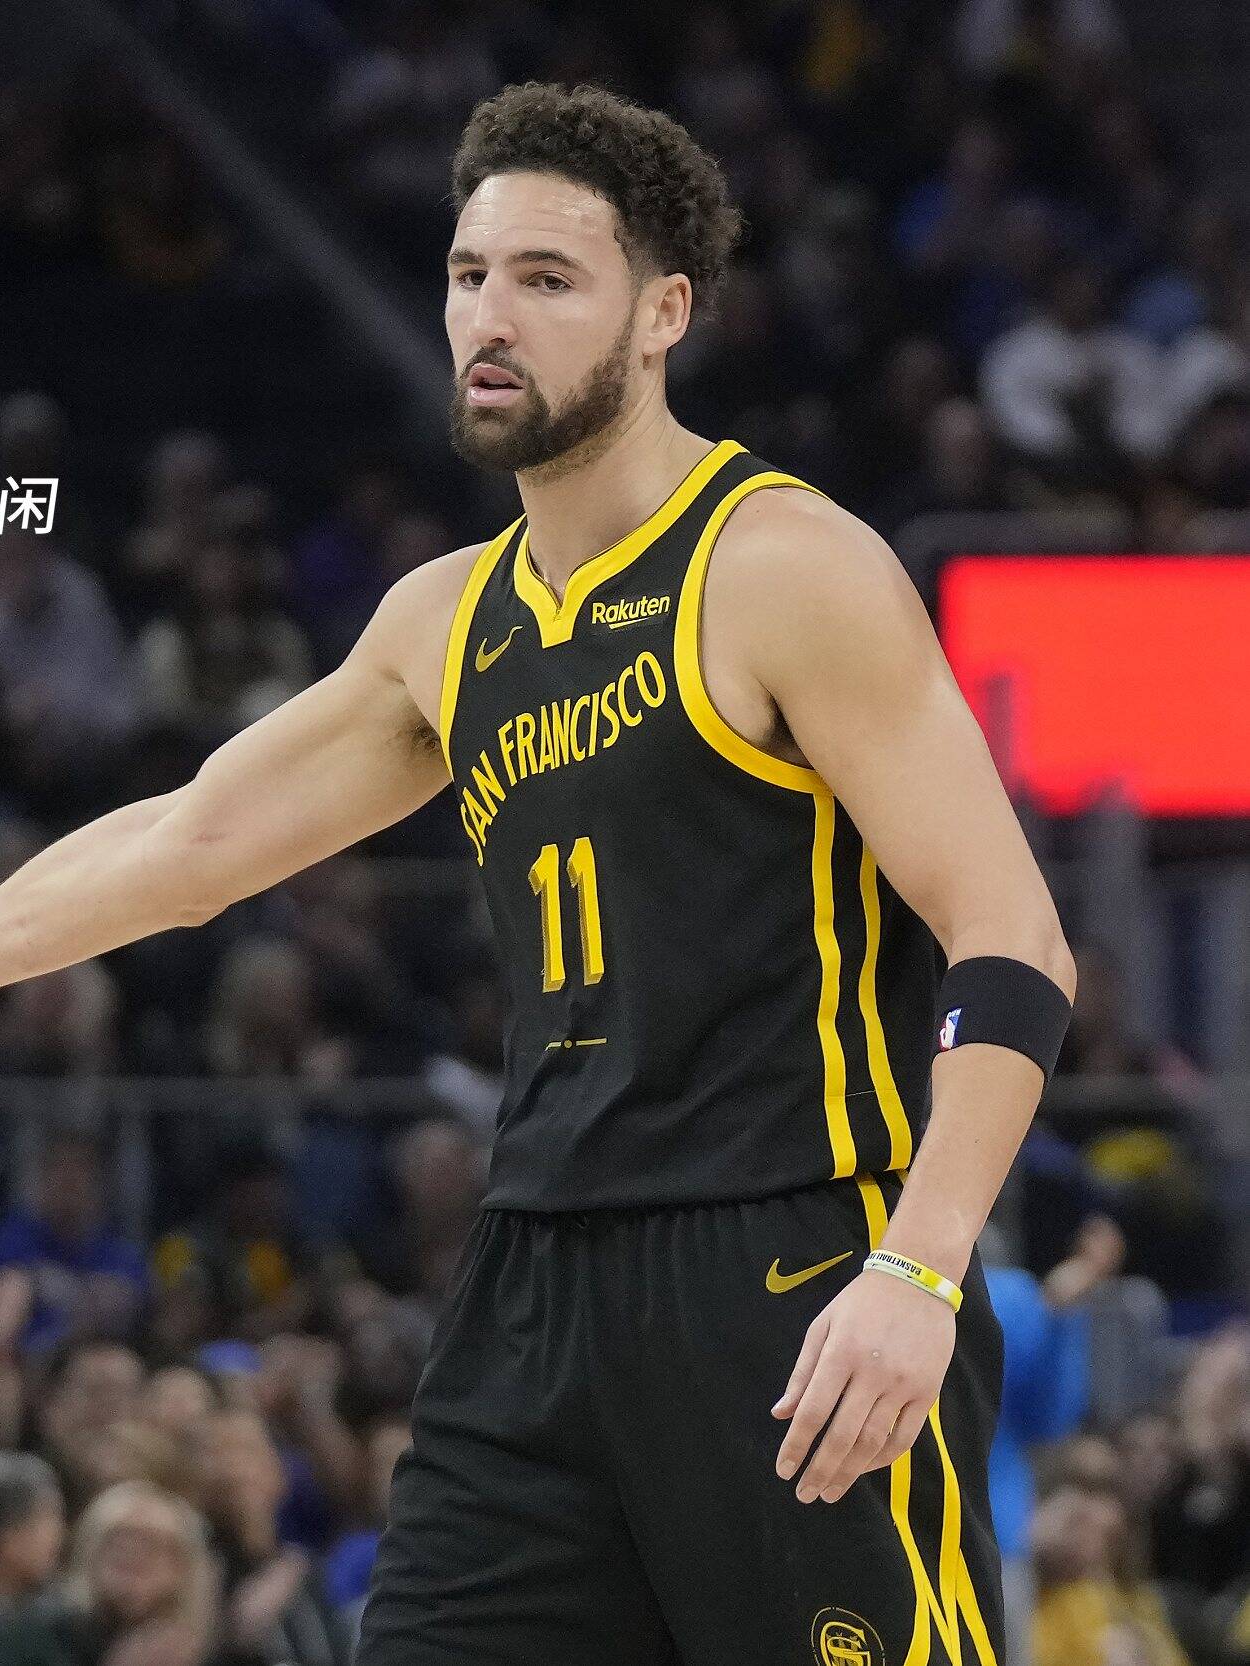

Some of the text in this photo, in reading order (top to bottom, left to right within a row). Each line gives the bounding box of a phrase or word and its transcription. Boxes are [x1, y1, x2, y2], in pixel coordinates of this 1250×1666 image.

[592, 595, 670, 627] Rakuten
[460, 651, 667, 867] SAN FRANCISCO
[527, 836, 605, 993] 11
